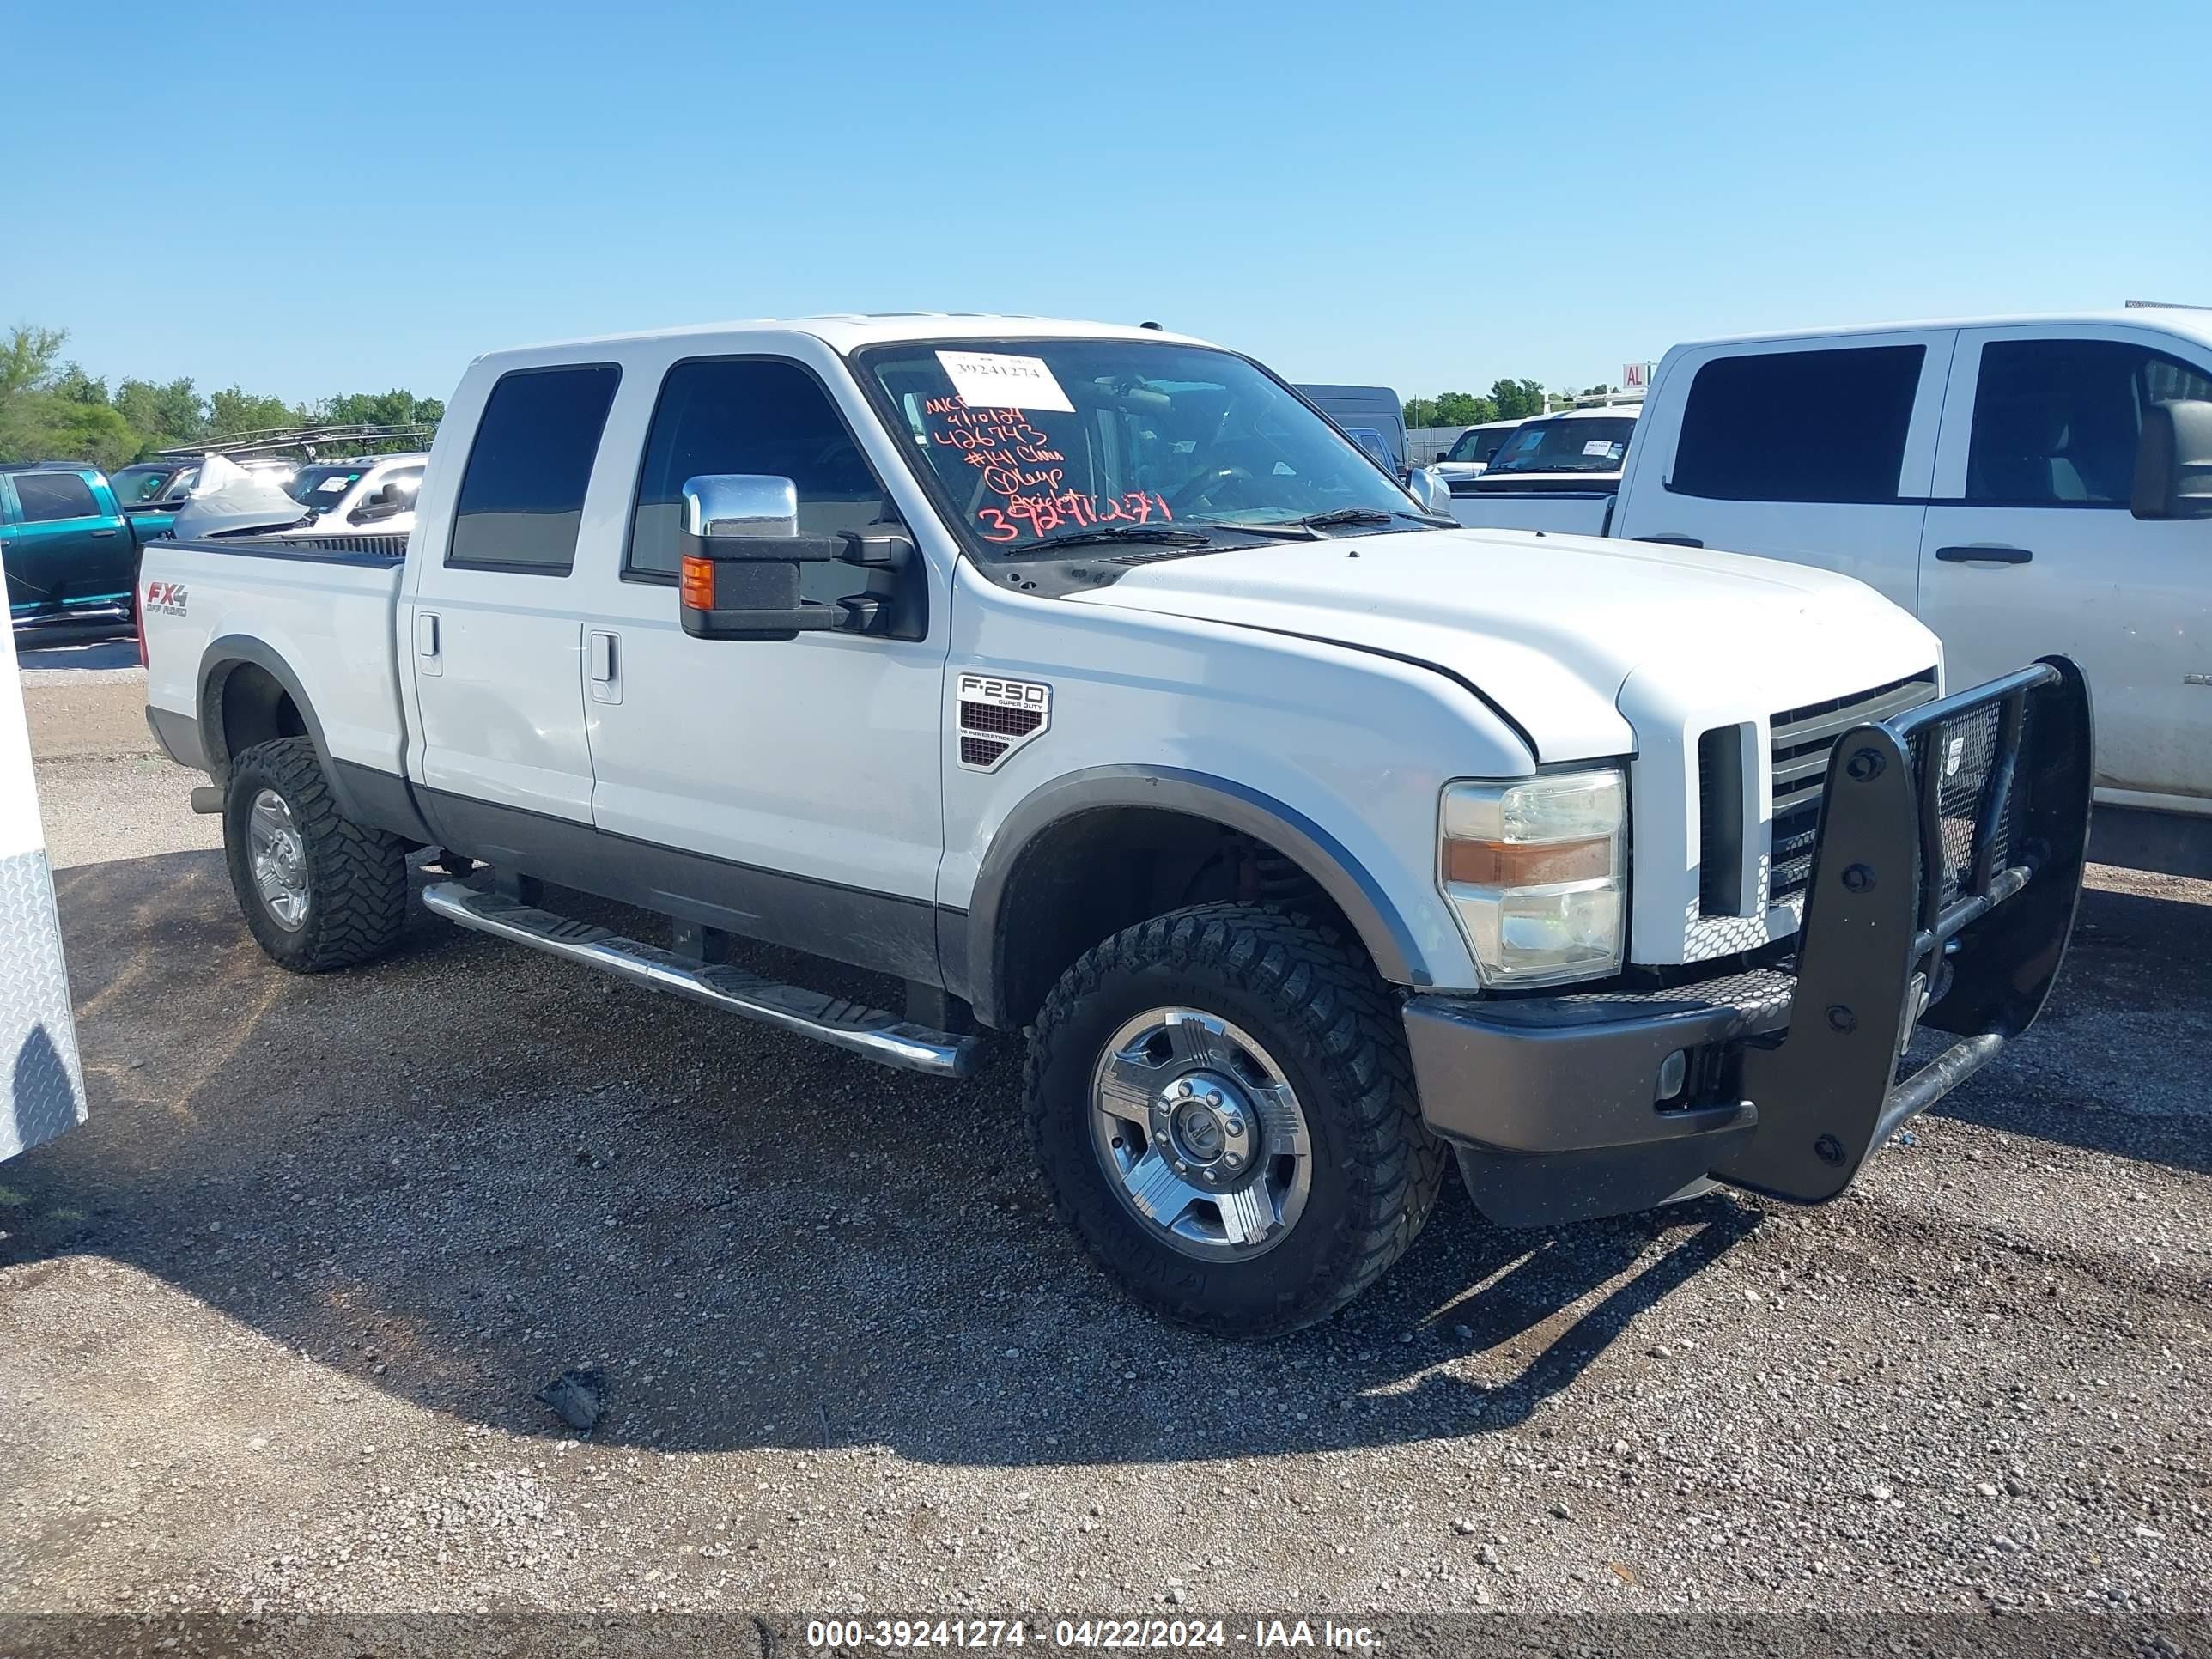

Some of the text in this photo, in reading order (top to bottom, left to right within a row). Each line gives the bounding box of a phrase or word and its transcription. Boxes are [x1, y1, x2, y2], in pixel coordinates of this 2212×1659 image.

[956, 363, 1041, 379] 39241274
[1627, 366, 1642, 386] AL
[934, 424, 1048, 450] 426743
[147, 581, 189, 607] FX4
[146, 603, 187, 617] OFF ROAD
[961, 678, 1044, 704] F-250
[1023, 702, 1043, 711] DUTY
[968, 730, 990, 738] POWER
